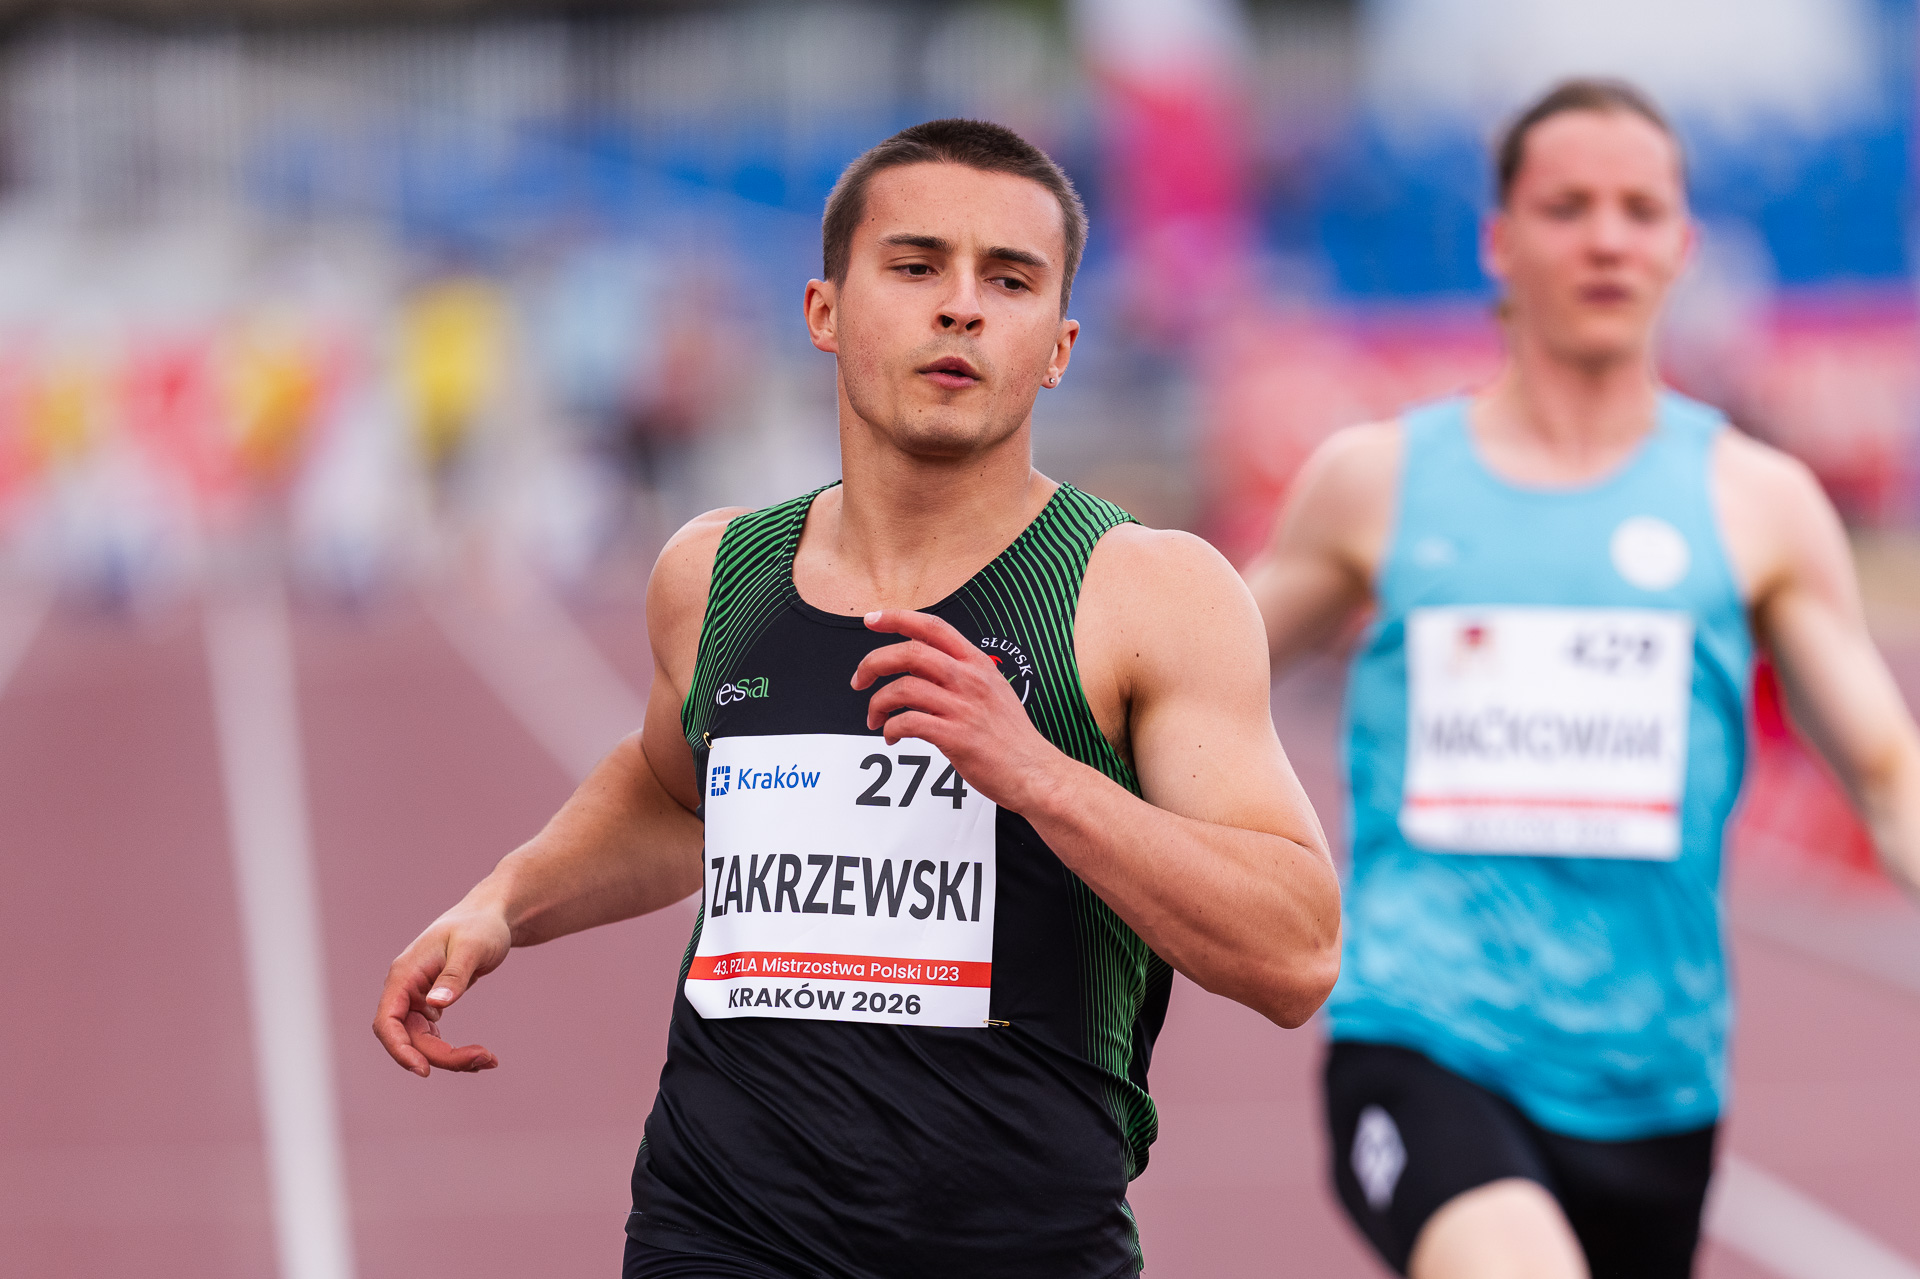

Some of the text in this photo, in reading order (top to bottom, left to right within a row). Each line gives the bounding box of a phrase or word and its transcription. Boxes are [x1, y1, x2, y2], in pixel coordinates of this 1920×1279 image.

[980, 637, 1034, 677] SŁUPSK
[737, 764, 821, 790] Kraków
[855, 753, 968, 810] 274
[711, 853, 983, 923] ZAKRZEWSKI
[713, 956, 960, 982] 43. PZLA Mistrzostwa Polski U23
[728, 982, 922, 1016] KRAKÓW 2026
